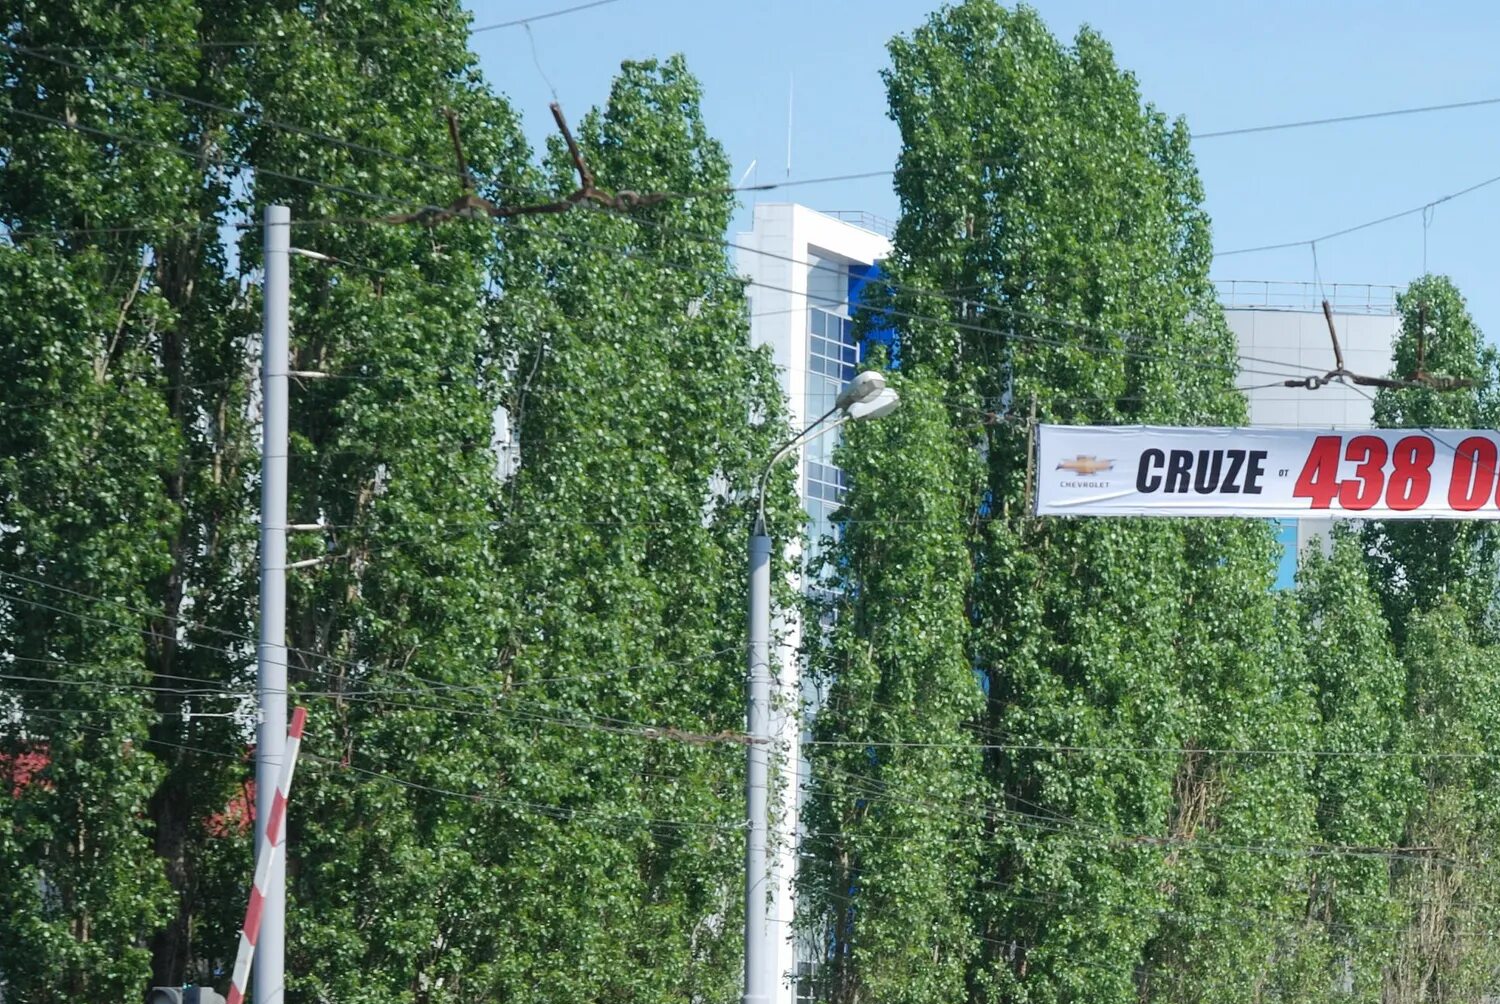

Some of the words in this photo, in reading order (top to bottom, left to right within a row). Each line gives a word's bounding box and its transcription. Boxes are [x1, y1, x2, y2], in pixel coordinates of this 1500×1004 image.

[1060, 481, 1110, 489] CHEVROLET
[1135, 447, 1268, 495] CRUZE
[1293, 435, 1436, 511] 438
